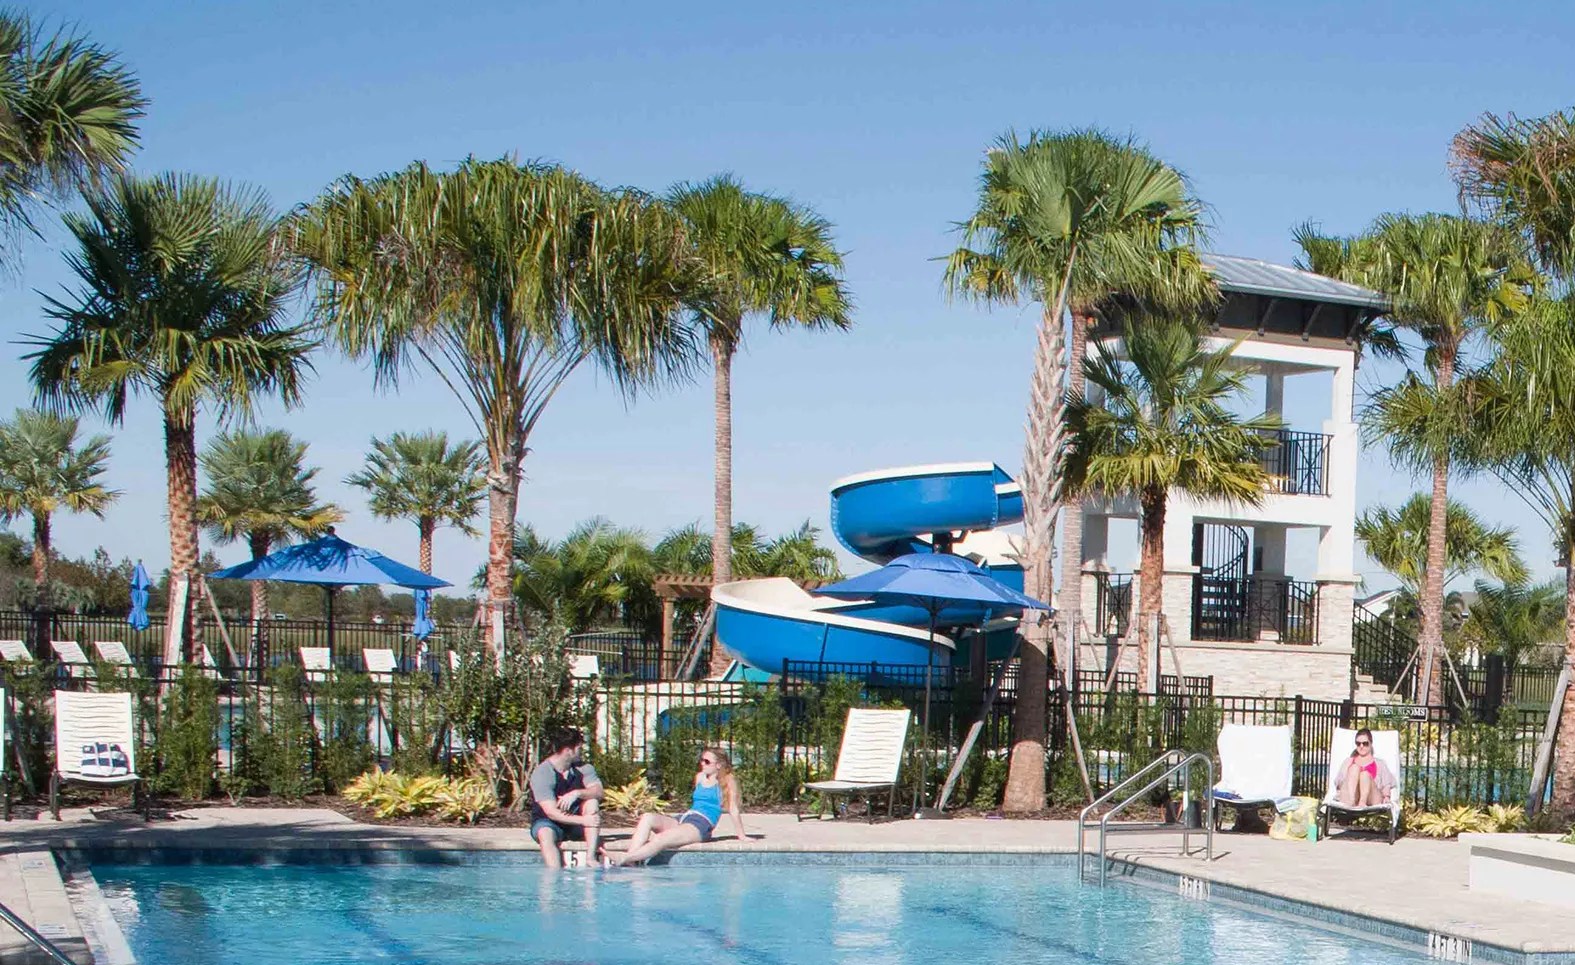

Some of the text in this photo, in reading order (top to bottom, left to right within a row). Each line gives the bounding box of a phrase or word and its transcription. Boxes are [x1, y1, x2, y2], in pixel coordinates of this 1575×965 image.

[1381, 706, 1425, 716] RESROOMS
[1440, 934, 1449, 952] FT
[1461, 939, 1470, 956] IN
